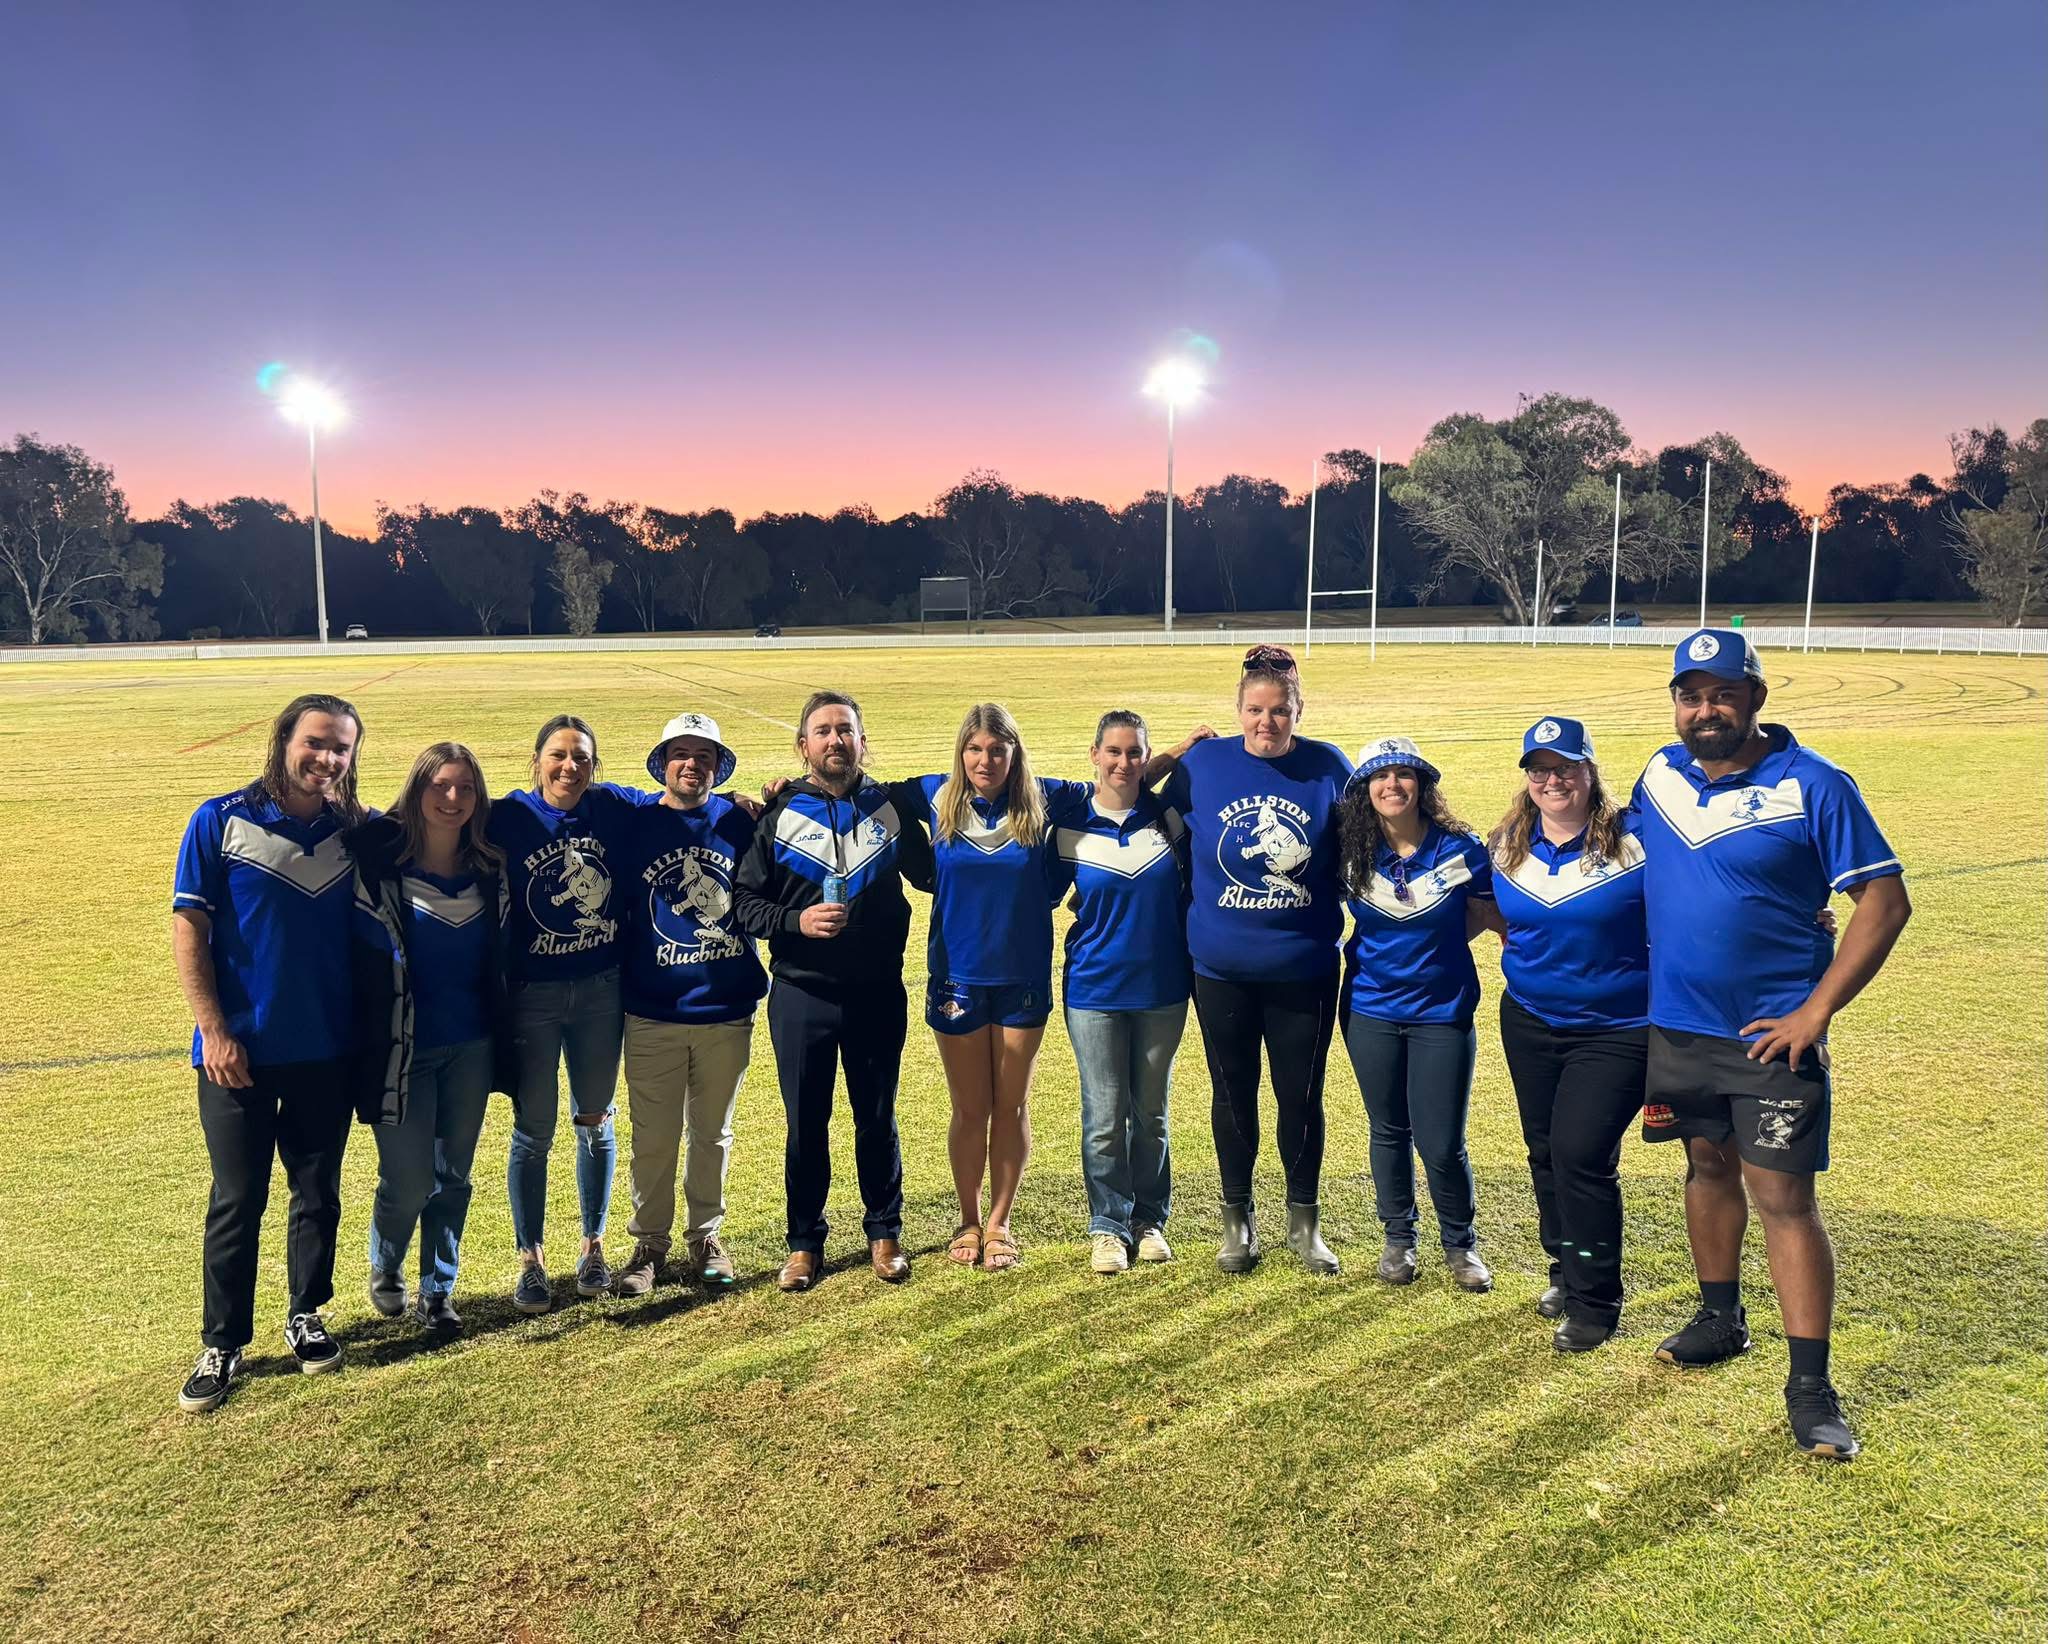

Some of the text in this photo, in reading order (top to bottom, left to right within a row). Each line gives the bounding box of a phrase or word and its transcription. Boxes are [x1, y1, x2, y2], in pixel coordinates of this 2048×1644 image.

[1218, 795, 1311, 825] HILLSTON
[1226, 820, 1251, 828] RLFC
[796, 833, 825, 842] JADE
[523, 837, 606, 871] HILLSTON
[642, 846, 735, 882] HILLSTON
[652, 878, 677, 886] RLFC
[1218, 885, 1312, 910] Bluebirds
[656, 935, 745, 966] Bluebirds
[1758, 1098, 1803, 1108] JADE
